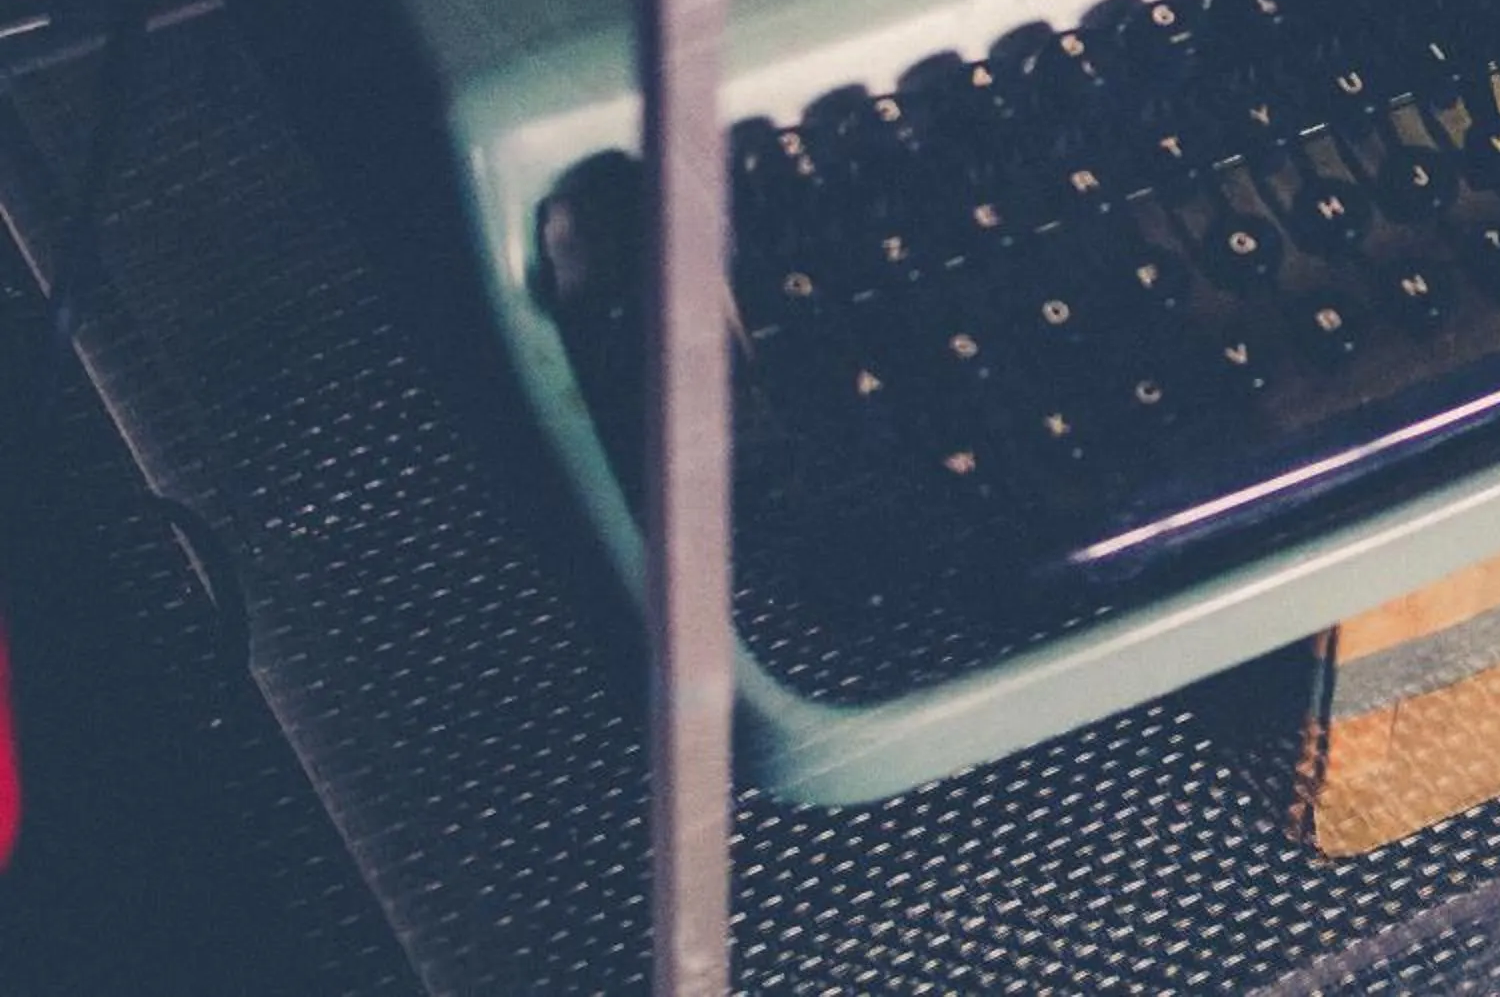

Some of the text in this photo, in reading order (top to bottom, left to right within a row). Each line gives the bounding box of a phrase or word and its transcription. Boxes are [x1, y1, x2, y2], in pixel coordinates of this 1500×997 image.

[1251, 106, 1269, 123] Y
[1339, 72, 1362, 92] U
[1319, 197, 1344, 218] H
[1415, 166, 1428, 185] J
[1226, 344, 1247, 363] V
[1402, 275, 1427, 295] N
